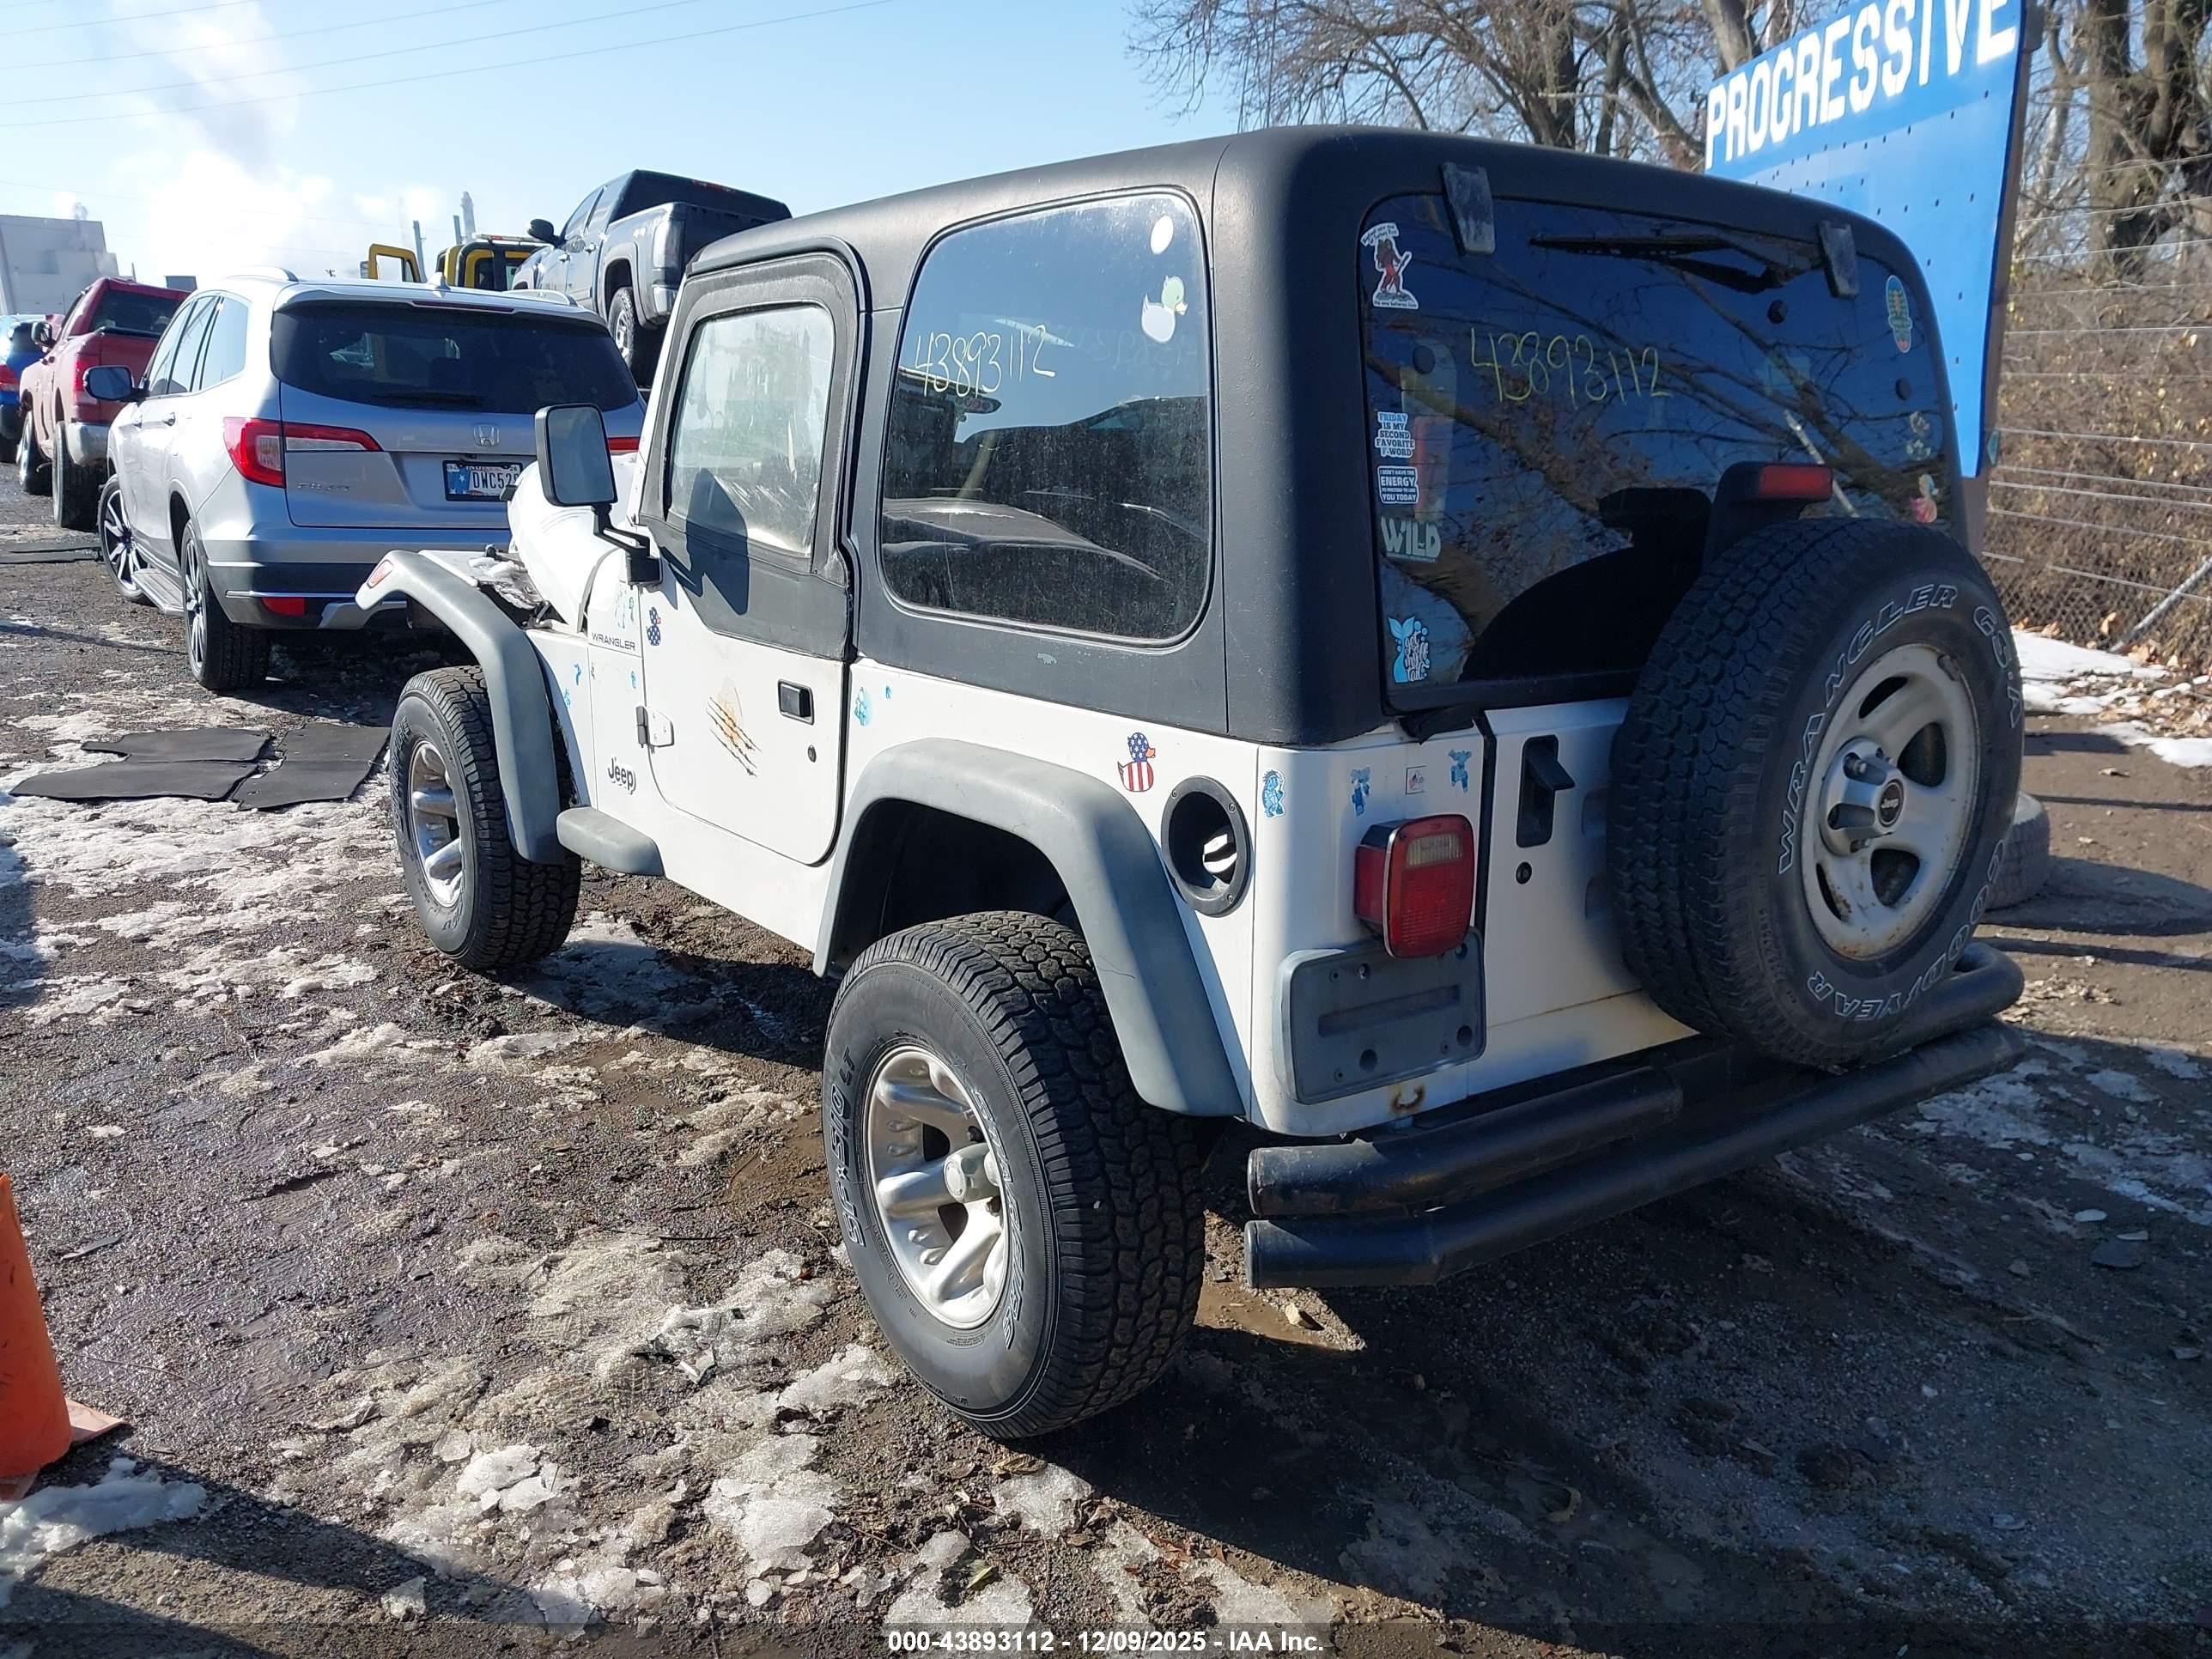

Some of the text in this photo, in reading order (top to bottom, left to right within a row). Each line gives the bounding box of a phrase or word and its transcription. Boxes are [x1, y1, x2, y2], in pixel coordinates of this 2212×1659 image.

[1706, 0, 2017, 170] PROGRESSIVE
[915, 325, 1055, 398] 43893112
[1470, 327, 1674, 410] 43893112
[1379, 413, 1407, 422] FRIDAY
[1376, 439, 1414, 448] FAVORITE
[1379, 430, 1410, 439] SECOND
[1382, 447, 1412, 456] F-WORD
[1381, 476, 1415, 487] ENERGY
[1381, 516, 1441, 558] WILD
[591, 632, 636, 651] WRANGLER
[1778, 583, 1959, 875] WRANGLER
[607, 757, 637, 795] Jeep
